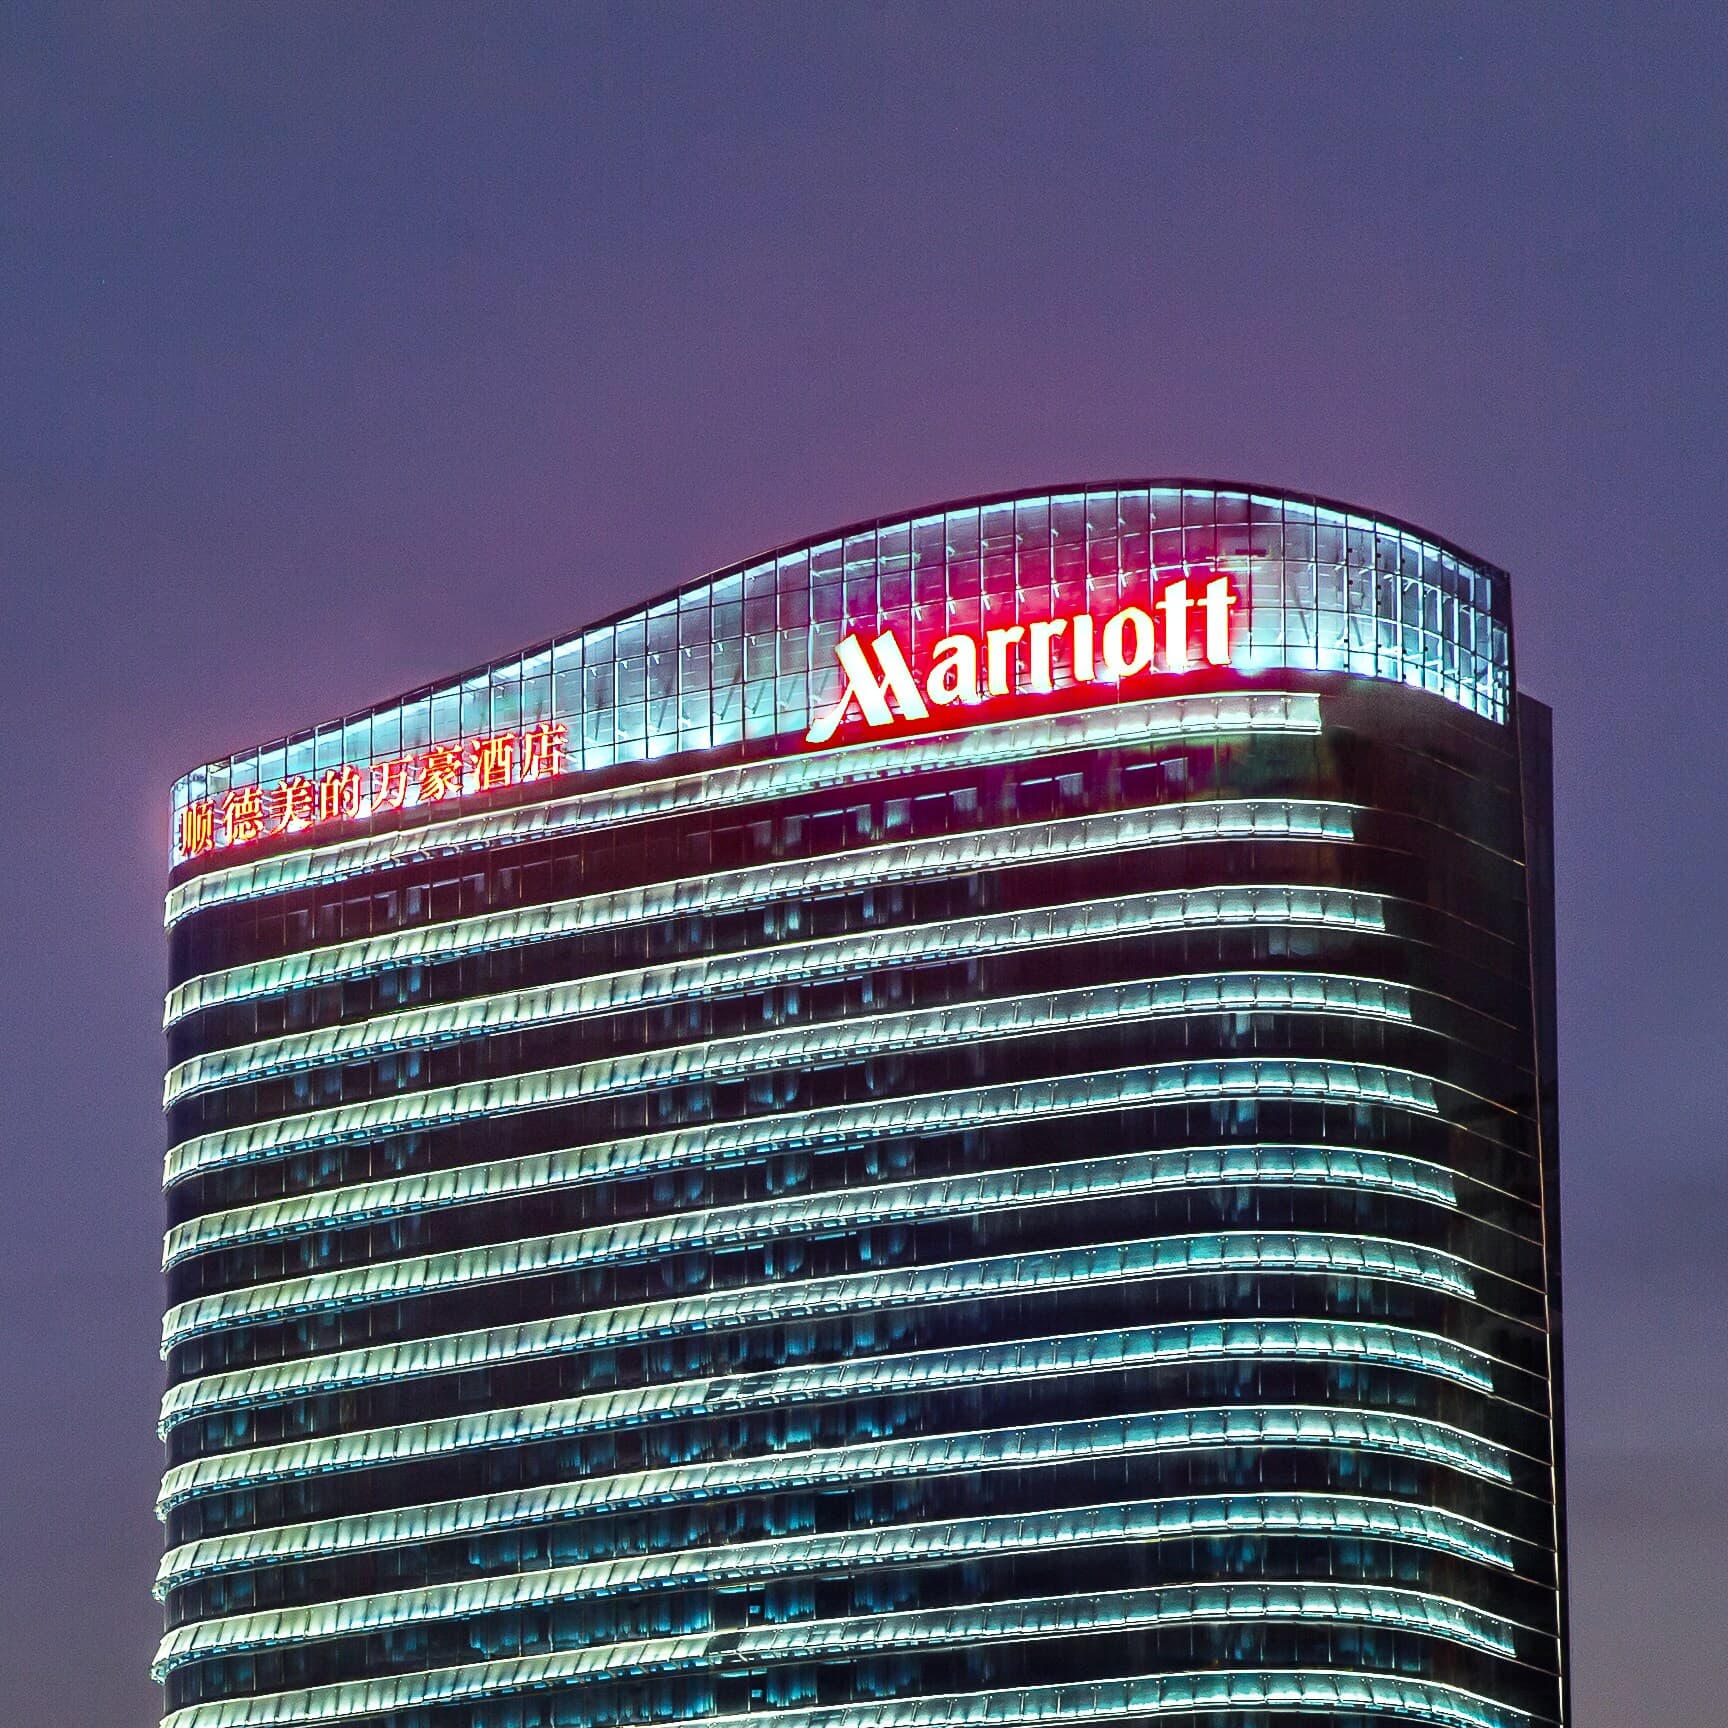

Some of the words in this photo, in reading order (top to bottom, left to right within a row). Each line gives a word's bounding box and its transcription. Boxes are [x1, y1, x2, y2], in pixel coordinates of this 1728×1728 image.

[805, 576, 1236, 743] Marriott
[179, 722, 569, 856] 顺德美的万豪酒店
